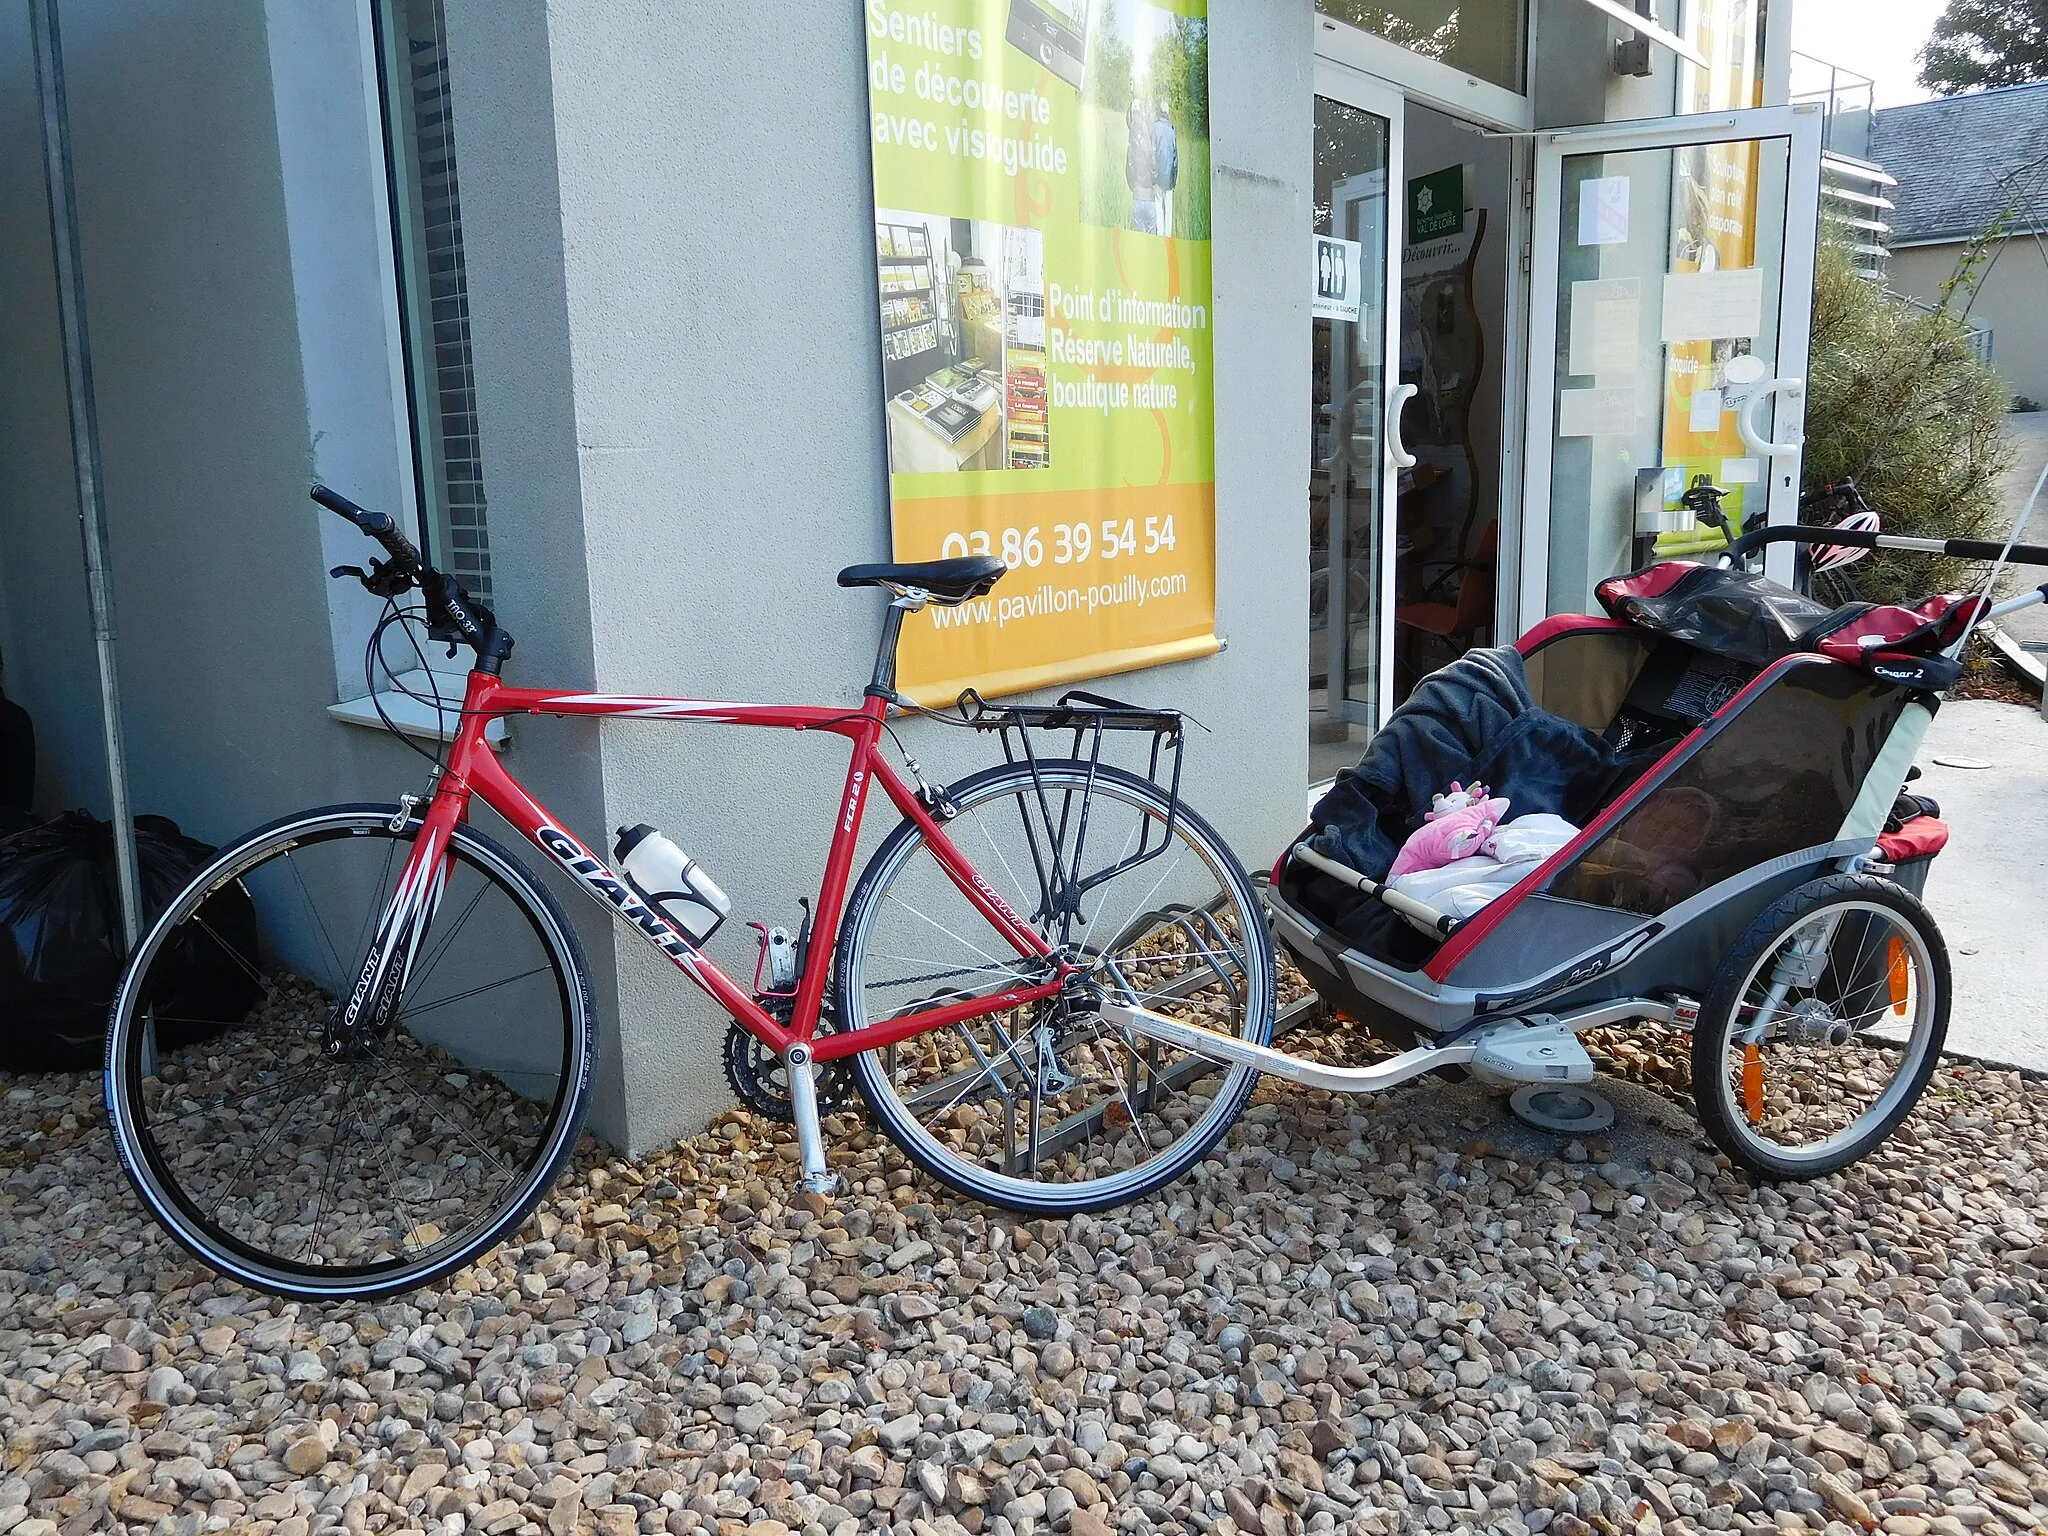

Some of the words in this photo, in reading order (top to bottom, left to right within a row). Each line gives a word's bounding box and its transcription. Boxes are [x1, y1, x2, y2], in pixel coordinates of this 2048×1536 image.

[870, 0, 983, 60] Sentiers
[872, 51, 906, 94] de
[914, 60, 1050, 125] découverte
[874, 111, 938, 152] avec
[944, 118, 1068, 176] visioguide
[1416, 224, 1428, 234] VAL
[1429, 220, 1438, 232] DE
[1439, 214, 1457, 230] LOIRE
[1049, 282, 1095, 322] Point
[1050, 327, 1123, 366] Réserve
[1127, 333, 1196, 375] Naturelle,
[1052, 373, 1129, 417] boutique
[1132, 379, 1177, 409] nature
[941, 531, 990, 559] 03
[1001, 526, 1043, 570] 86
[1053, 522, 1092, 564] 39
[1101, 518, 1136, 559] 54
[1144, 514, 1176, 554] 54
[930, 571, 1187, 629] www.pavillon-pouilly.com
[1874, 666, 1914, 678] Cougar
[1914, 668, 1924, 678] 2
[843, 796, 858, 833] FCR
[851, 782, 860, 797] 2
[536, 825, 712, 970] GIANT
[971, 874, 1029, 929] GIANT
[344, 946, 380, 1026] GIANT
[375, 949, 405, 1026] GIANT
[1268, 961, 1276, 1017] SCHWALBE
[104, 1013, 117, 1070] MARATHON
[113, 982, 124, 1011] PLUS
[108, 1110, 131, 1170] SCHWALBE
